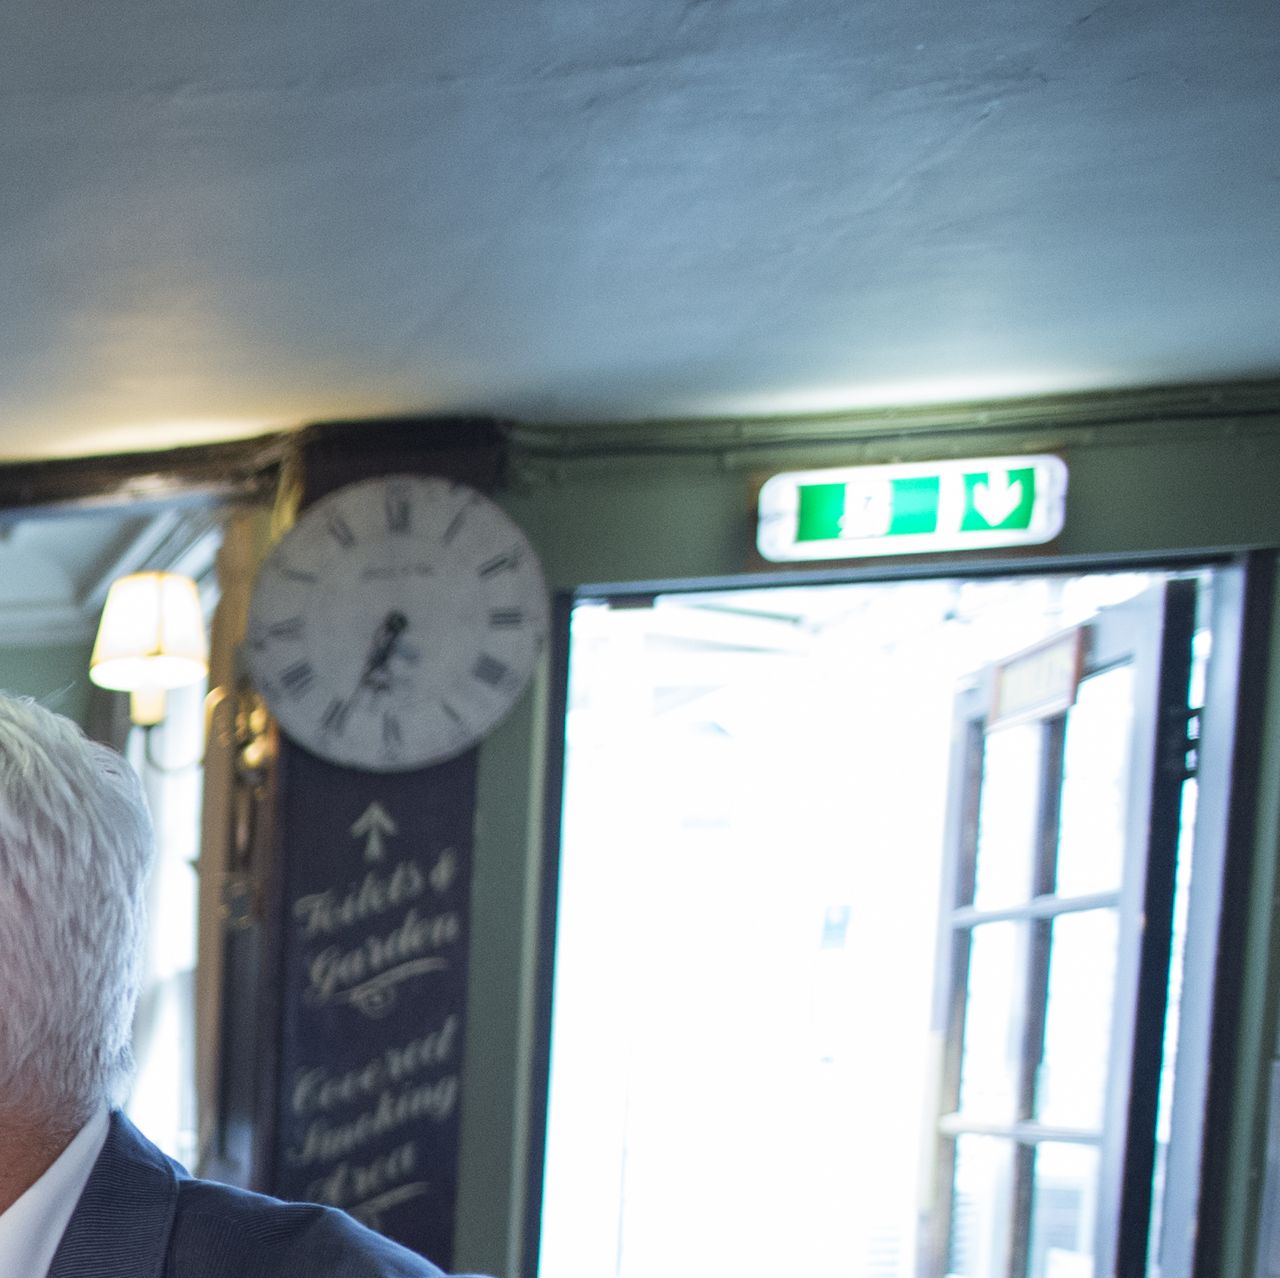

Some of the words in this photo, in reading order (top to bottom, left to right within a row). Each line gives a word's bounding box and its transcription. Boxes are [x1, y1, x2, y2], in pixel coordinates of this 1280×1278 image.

[307, 907, 460, 1001] Garden
[293, 1014, 459, 1115] Covered
[288, 1075, 458, 1167] Smoking
[310, 1141, 416, 1202] Area
